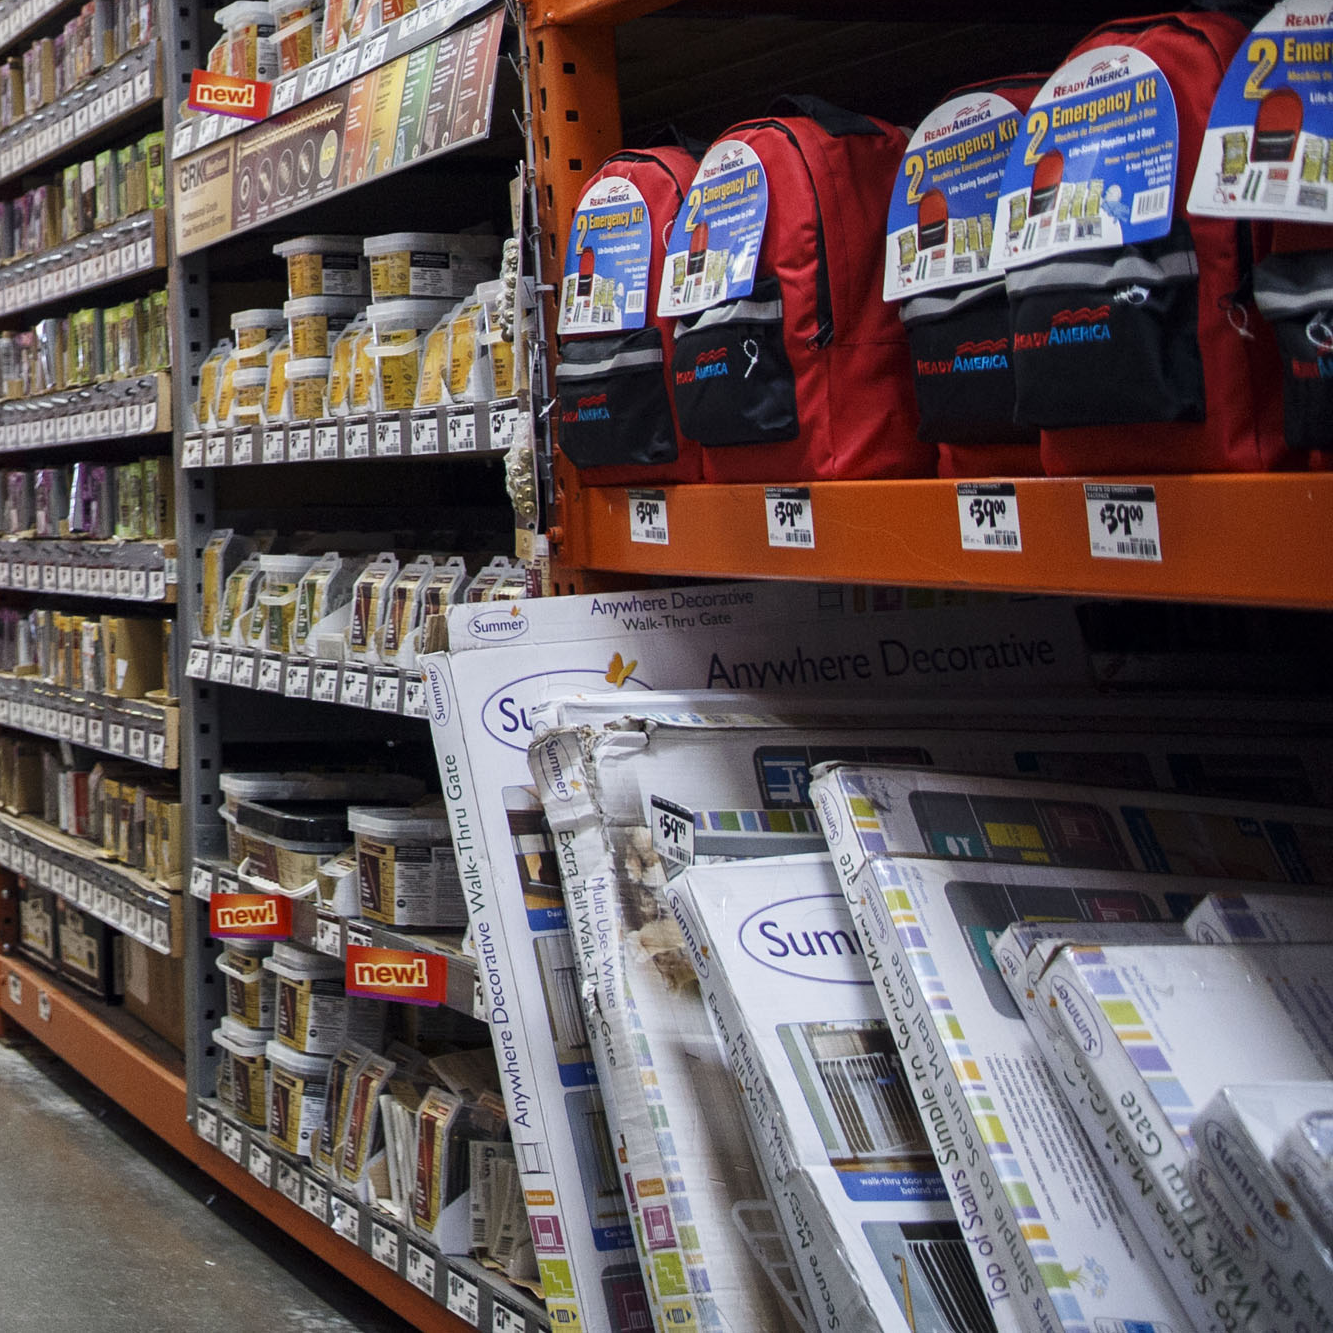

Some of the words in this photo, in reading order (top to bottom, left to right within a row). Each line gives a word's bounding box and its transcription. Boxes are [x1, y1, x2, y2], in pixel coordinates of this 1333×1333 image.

[197, 85, 256, 107] new!
[1053, 66, 1130, 98] READYAMERICA
[1244, 37, 1279, 100] 2
[924, 109, 991, 143] READYAMERICA
[1024, 111, 1049, 166] 2
[1052, 89, 1132, 128] Emergency
[1136, 77, 1157, 104] Kit
[703, 158, 744, 179] READYAMERICA
[905, 155, 925, 205] 2
[926, 129, 995, 170] Emergency
[998, 118, 1019, 143] Kit
[590, 193, 630, 207] READYAMERICA
[685, 189, 701, 233] 2
[702, 178, 746, 204] Emergency
[747, 170, 759, 188] Kit
[575, 215, 588, 255] 2
[589, 213, 630, 231] Emergency
[632, 207, 643, 223] Kit
[473, 619, 524, 634] Summer
[591, 596, 667, 618] Anywhere
[672, 590, 754, 609] Decorative
[623, 614, 695, 632] Walk-Thru
[700, 612, 732, 626] Gate
[707, 647, 872, 689] Anywhere
[880, 634, 1055, 677] Decorative
[429, 667, 447, 721] Summer
[445, 754, 463, 800] Gate
[545, 739, 569, 797] Summer
[448, 806, 486, 915] Walk-Thru
[219, 901, 276, 927] new!
[591, 877, 608, 916] Multi
[558, 829, 579, 879] Extra
[572, 880, 588, 911] Tall
[600, 1021, 617, 1068] Gate
[669, 892, 708, 970] Summer
[357, 961, 427, 986] new!
[477, 921, 509, 1024] Decorative
[889, 951, 914, 1012] Gate
[707, 992, 730, 1044] Extra
[1053, 984, 1097, 1053] Summer
[913, 1015, 945, 1081] Metal
[492, 1028, 530, 1128] Anywhere
[940, 1083, 981, 1162] Secure
[1121, 1092, 1162, 1158] Gate
[952, 1165, 983, 1230] Stairs
[979, 1172, 999, 1194] to
[1210, 1128, 1286, 1246] Summer
[975, 1231, 994, 1262] of
[991, 1215, 1036, 1294] Simple
[980, 1264, 1010, 1306] Top
